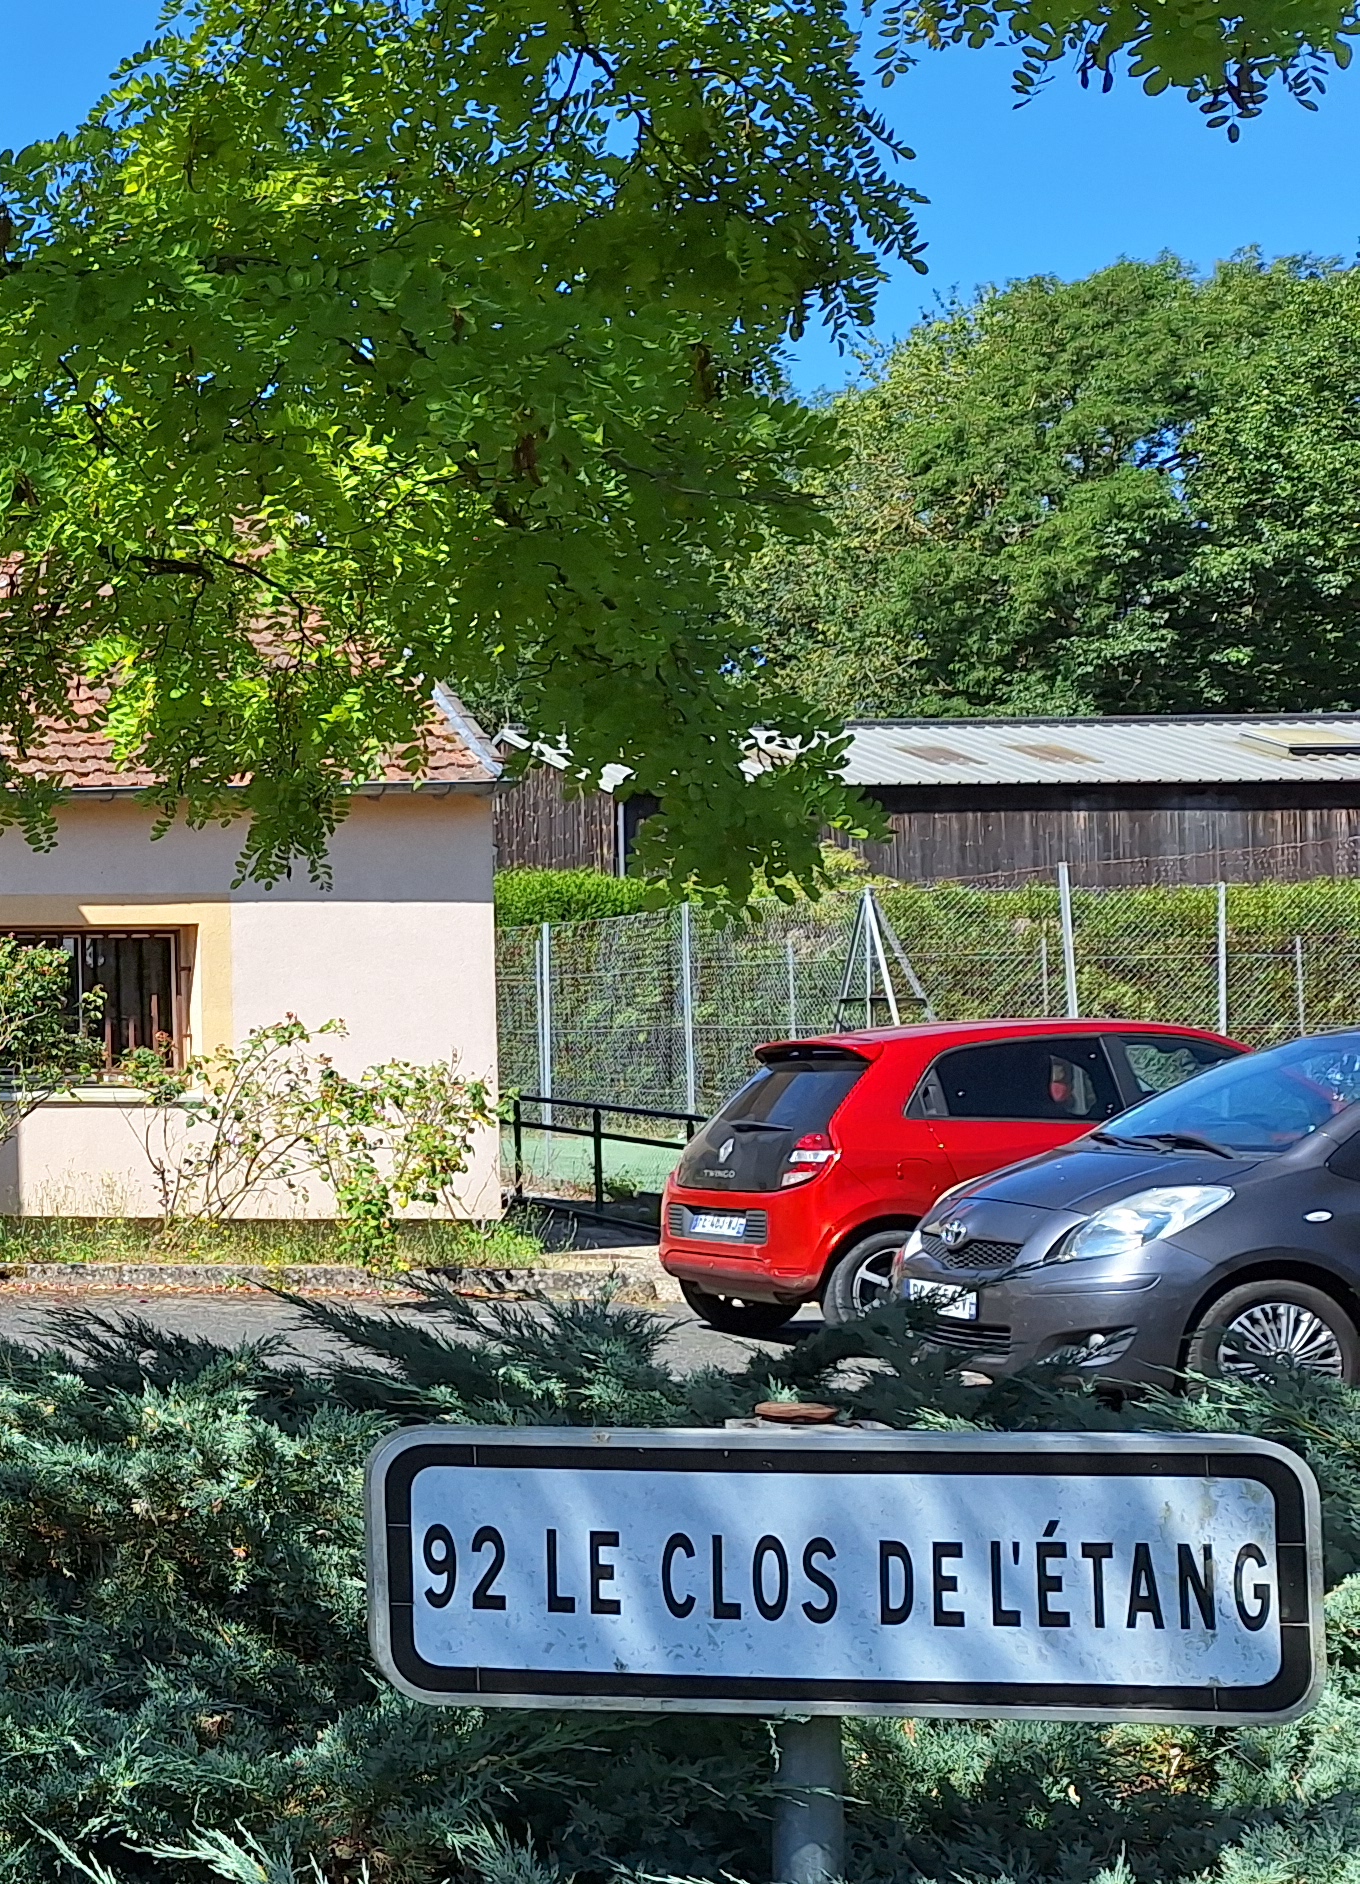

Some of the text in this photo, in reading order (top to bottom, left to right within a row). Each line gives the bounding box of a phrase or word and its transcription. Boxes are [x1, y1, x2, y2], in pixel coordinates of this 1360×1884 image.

[422, 1519, 1271, 1632] 92 LE CLOS DE L'ÉTANG
